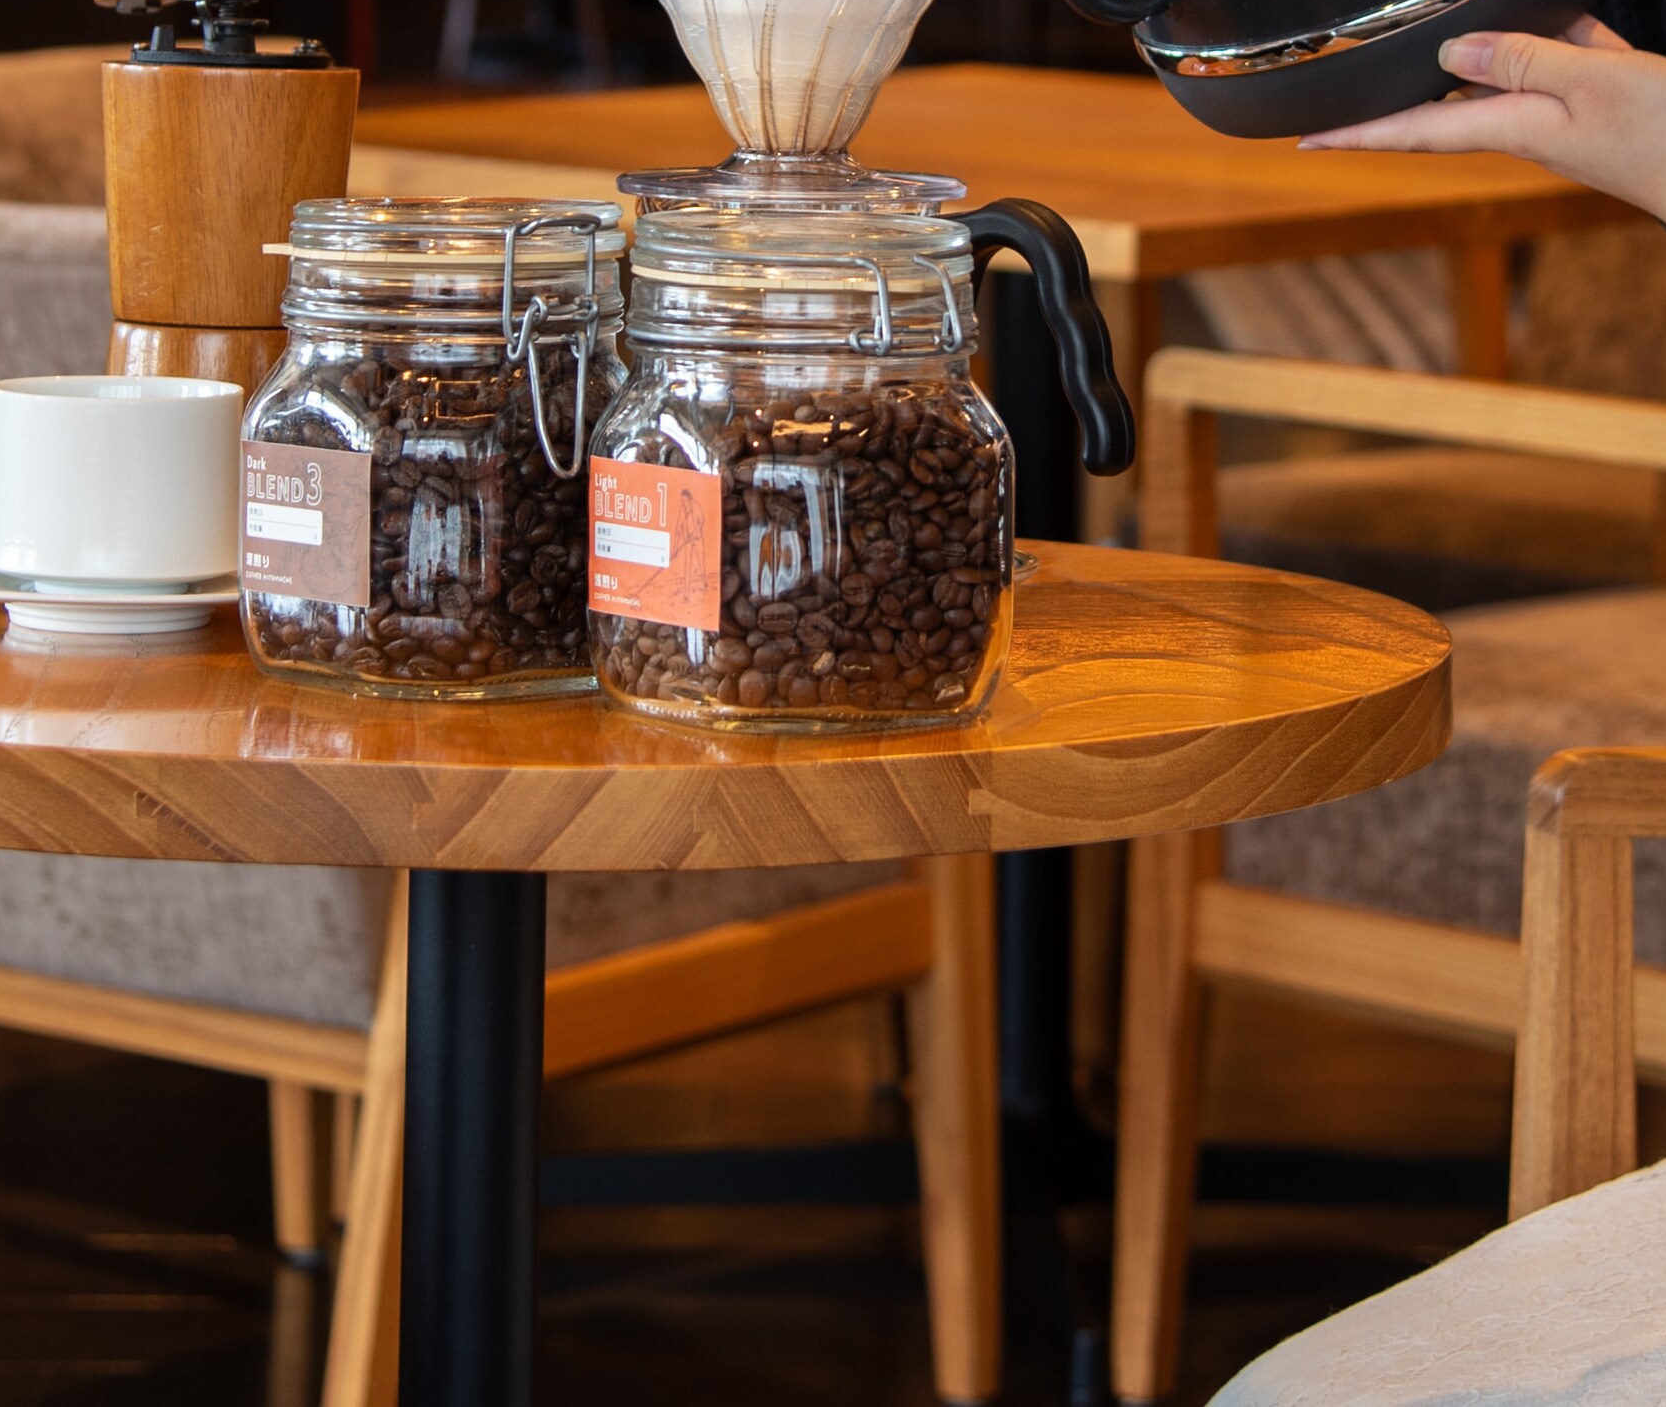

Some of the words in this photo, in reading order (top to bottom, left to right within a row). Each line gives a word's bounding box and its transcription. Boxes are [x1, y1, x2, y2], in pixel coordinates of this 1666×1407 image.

[246, 454, 267, 471] Dark
[246, 471, 304, 503] BLEND
[306, 461, 323, 506] 3
[594, 472, 618, 492] Light
[594, 490, 652, 523] BLEND
[657, 482, 668, 527] 1
